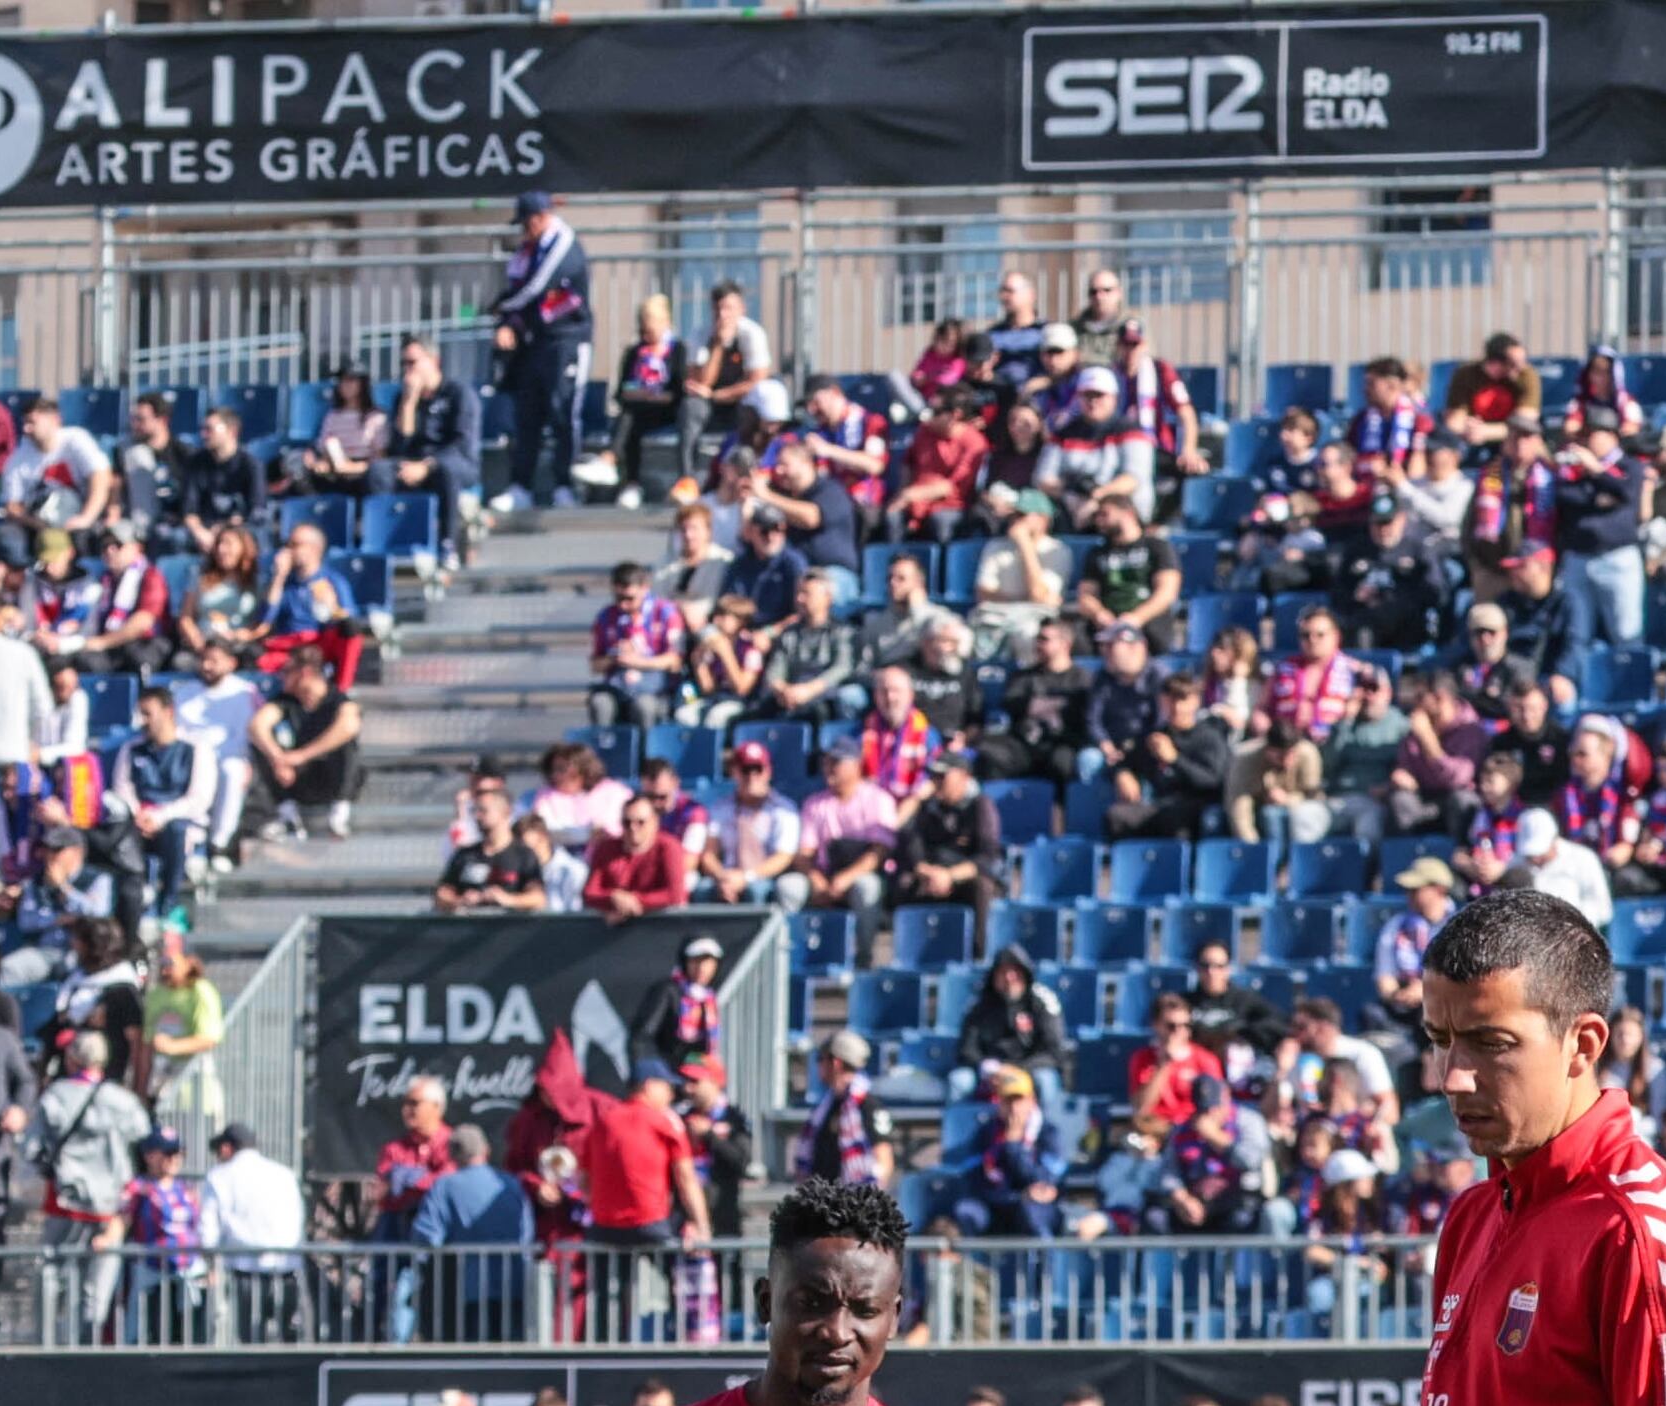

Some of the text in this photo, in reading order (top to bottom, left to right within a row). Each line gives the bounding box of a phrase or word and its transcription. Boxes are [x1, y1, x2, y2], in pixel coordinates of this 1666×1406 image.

[54, 48, 542, 130] ALIPACK
[1303, 67, 1391, 98] Radio
[1303, 100, 1388, 130] ELDA
[54, 127, 546, 186] ARTES GRÁFICAS
[358, 983, 545, 1045] ELDA
